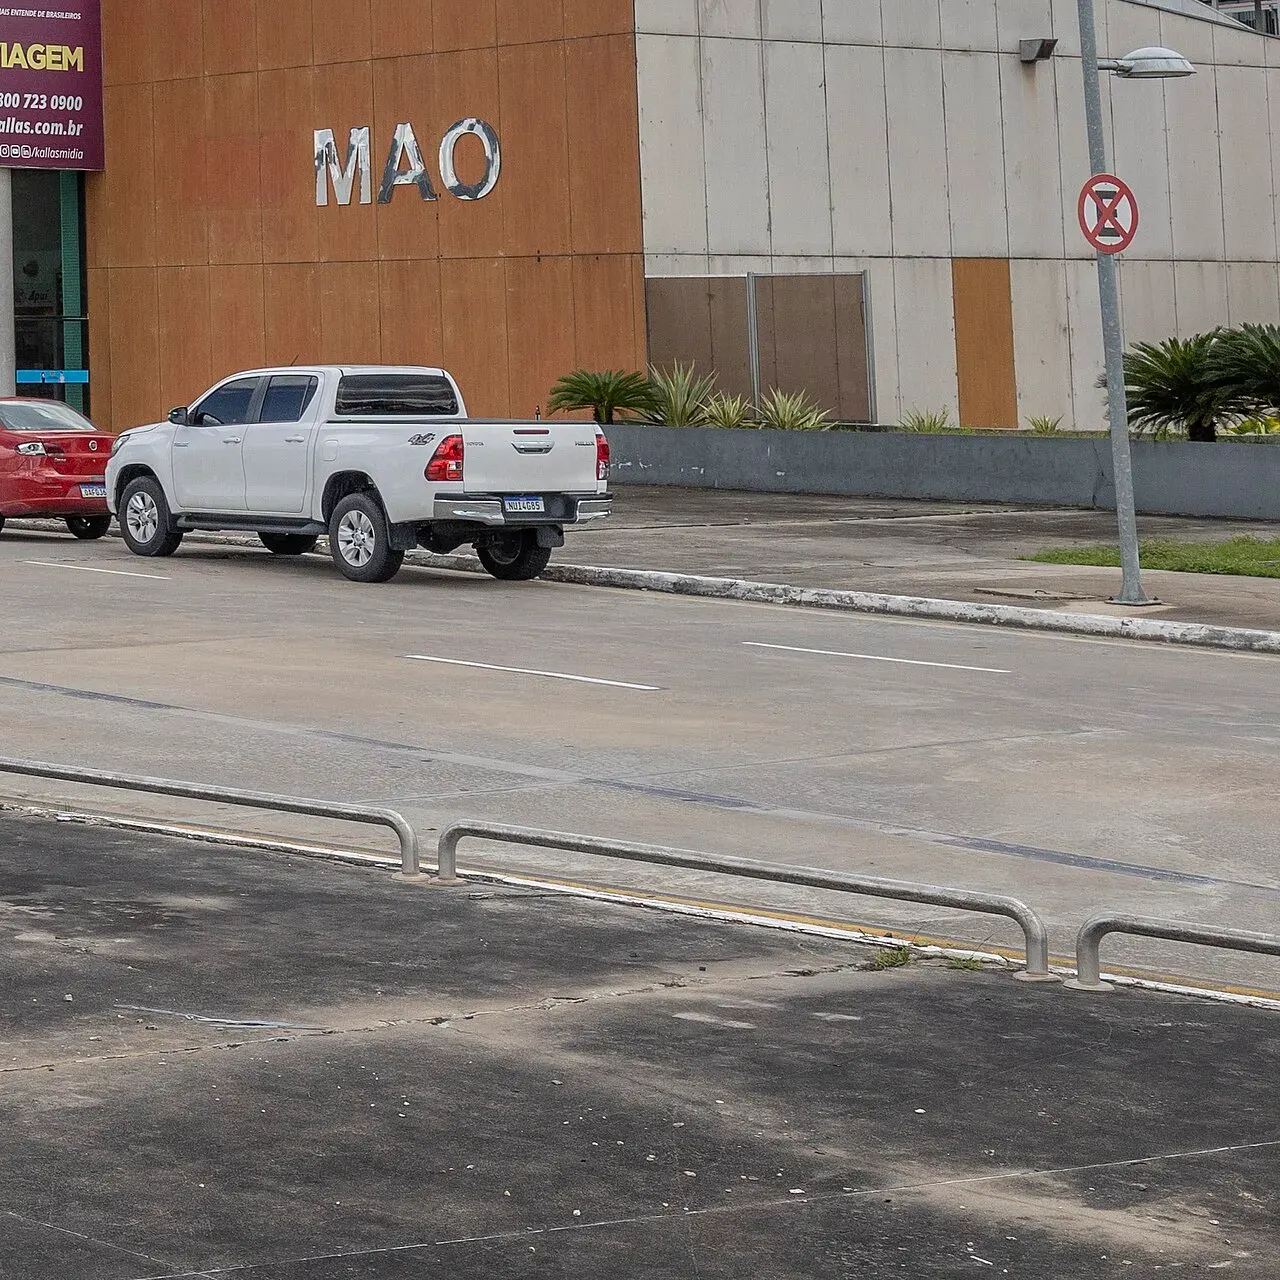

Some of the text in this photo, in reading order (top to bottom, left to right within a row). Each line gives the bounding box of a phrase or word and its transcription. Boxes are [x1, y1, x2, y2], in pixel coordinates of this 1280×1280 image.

[10, 9, 37, 17] ENTENDE
[46, 11, 82, 20] BRASILEIROS
[23, 94, 47, 109] 723
[50, 95, 83, 111] 0900
[313, 117, 501, 207] MAO
